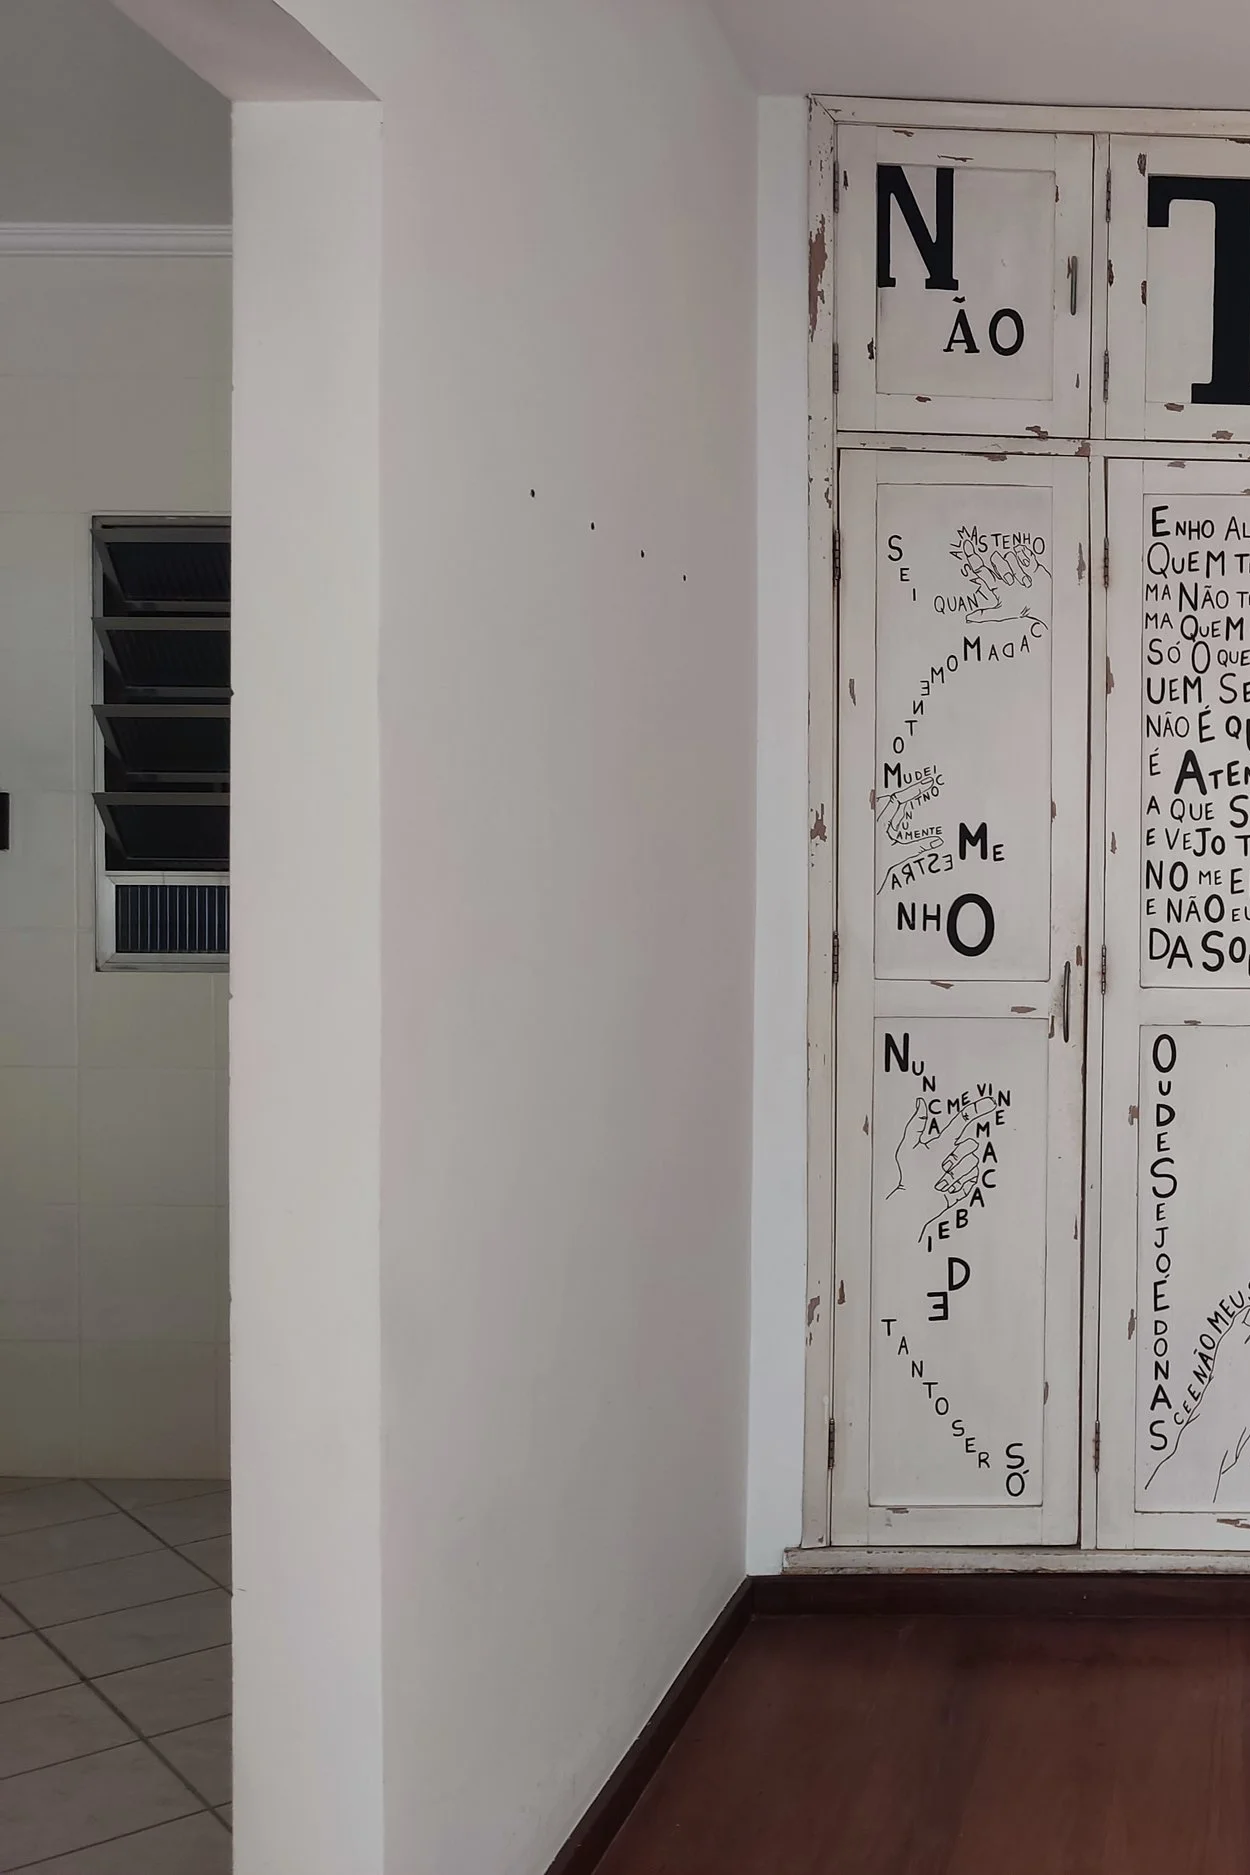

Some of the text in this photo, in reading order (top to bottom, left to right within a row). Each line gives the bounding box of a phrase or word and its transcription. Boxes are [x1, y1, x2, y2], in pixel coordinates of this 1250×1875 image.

[1152, 505, 1215, 540] ENHO
[1147, 542, 1225, 578] QUEM
[1145, 584, 1172, 601] MA
[1178, 582, 1229, 612] NÃO
[1145, 612, 1173, 630] MA
[1180, 614, 1244, 643] QUEM
[1147, 638, 1181, 665] SÓ
[1217, 649, 1250, 667] QUE
[1146, 675, 1202, 704] UEM
[1146, 711, 1190, 738] NÃO
[1170, 798, 1215, 823] QUE
[959, 822, 1005, 861] ME
[1164, 827, 1226, 857] VEJO
[1145, 860, 1188, 892] NO
[1199, 869, 1223, 885] ME
[1167, 894, 1225, 923] NÃO
[897, 893, 995, 957] NHO
